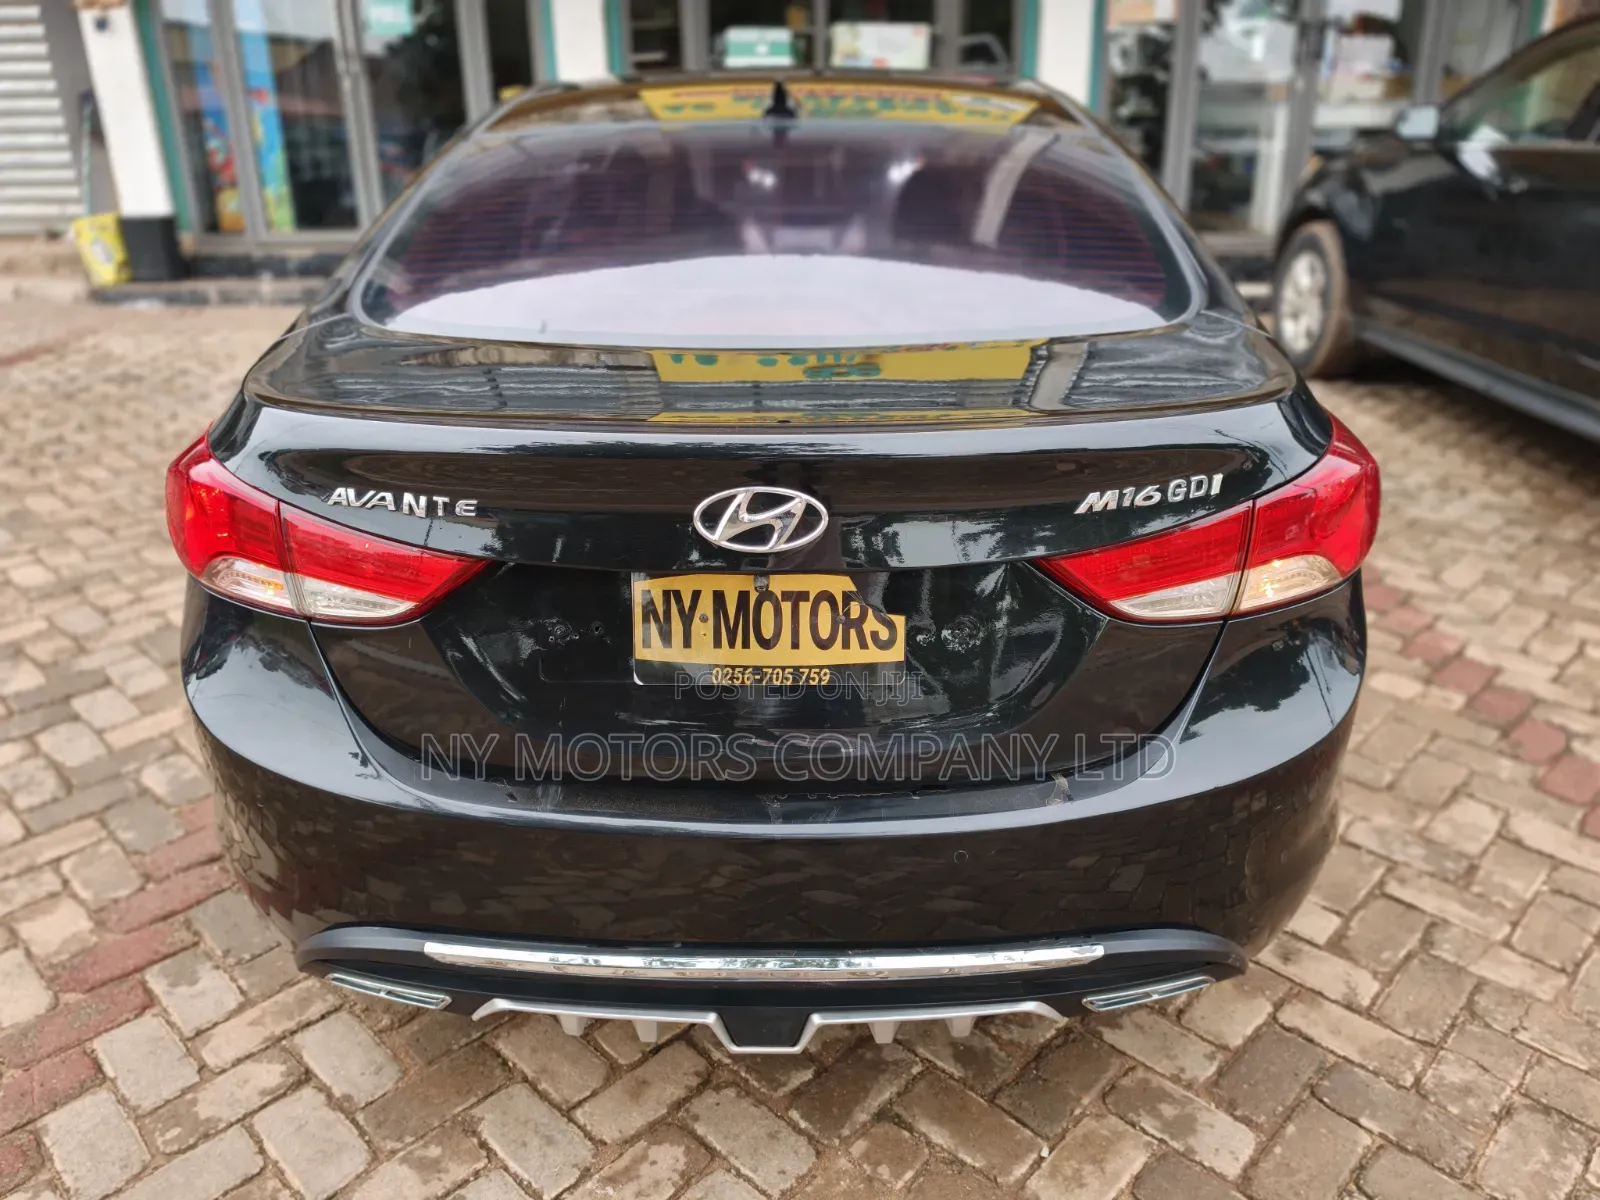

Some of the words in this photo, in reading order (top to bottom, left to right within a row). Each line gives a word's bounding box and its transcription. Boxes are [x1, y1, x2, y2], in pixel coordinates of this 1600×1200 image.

[327, 487, 479, 518] AVANTE
[1073, 485, 1162, 515] M16
[1167, 473, 1224, 503] GDI
[641, 589, 702, 650] NY
[712, 589, 898, 651] MOTORS
[711, 667, 793, 685] 0256-705
[799, 667, 830, 685] 759
